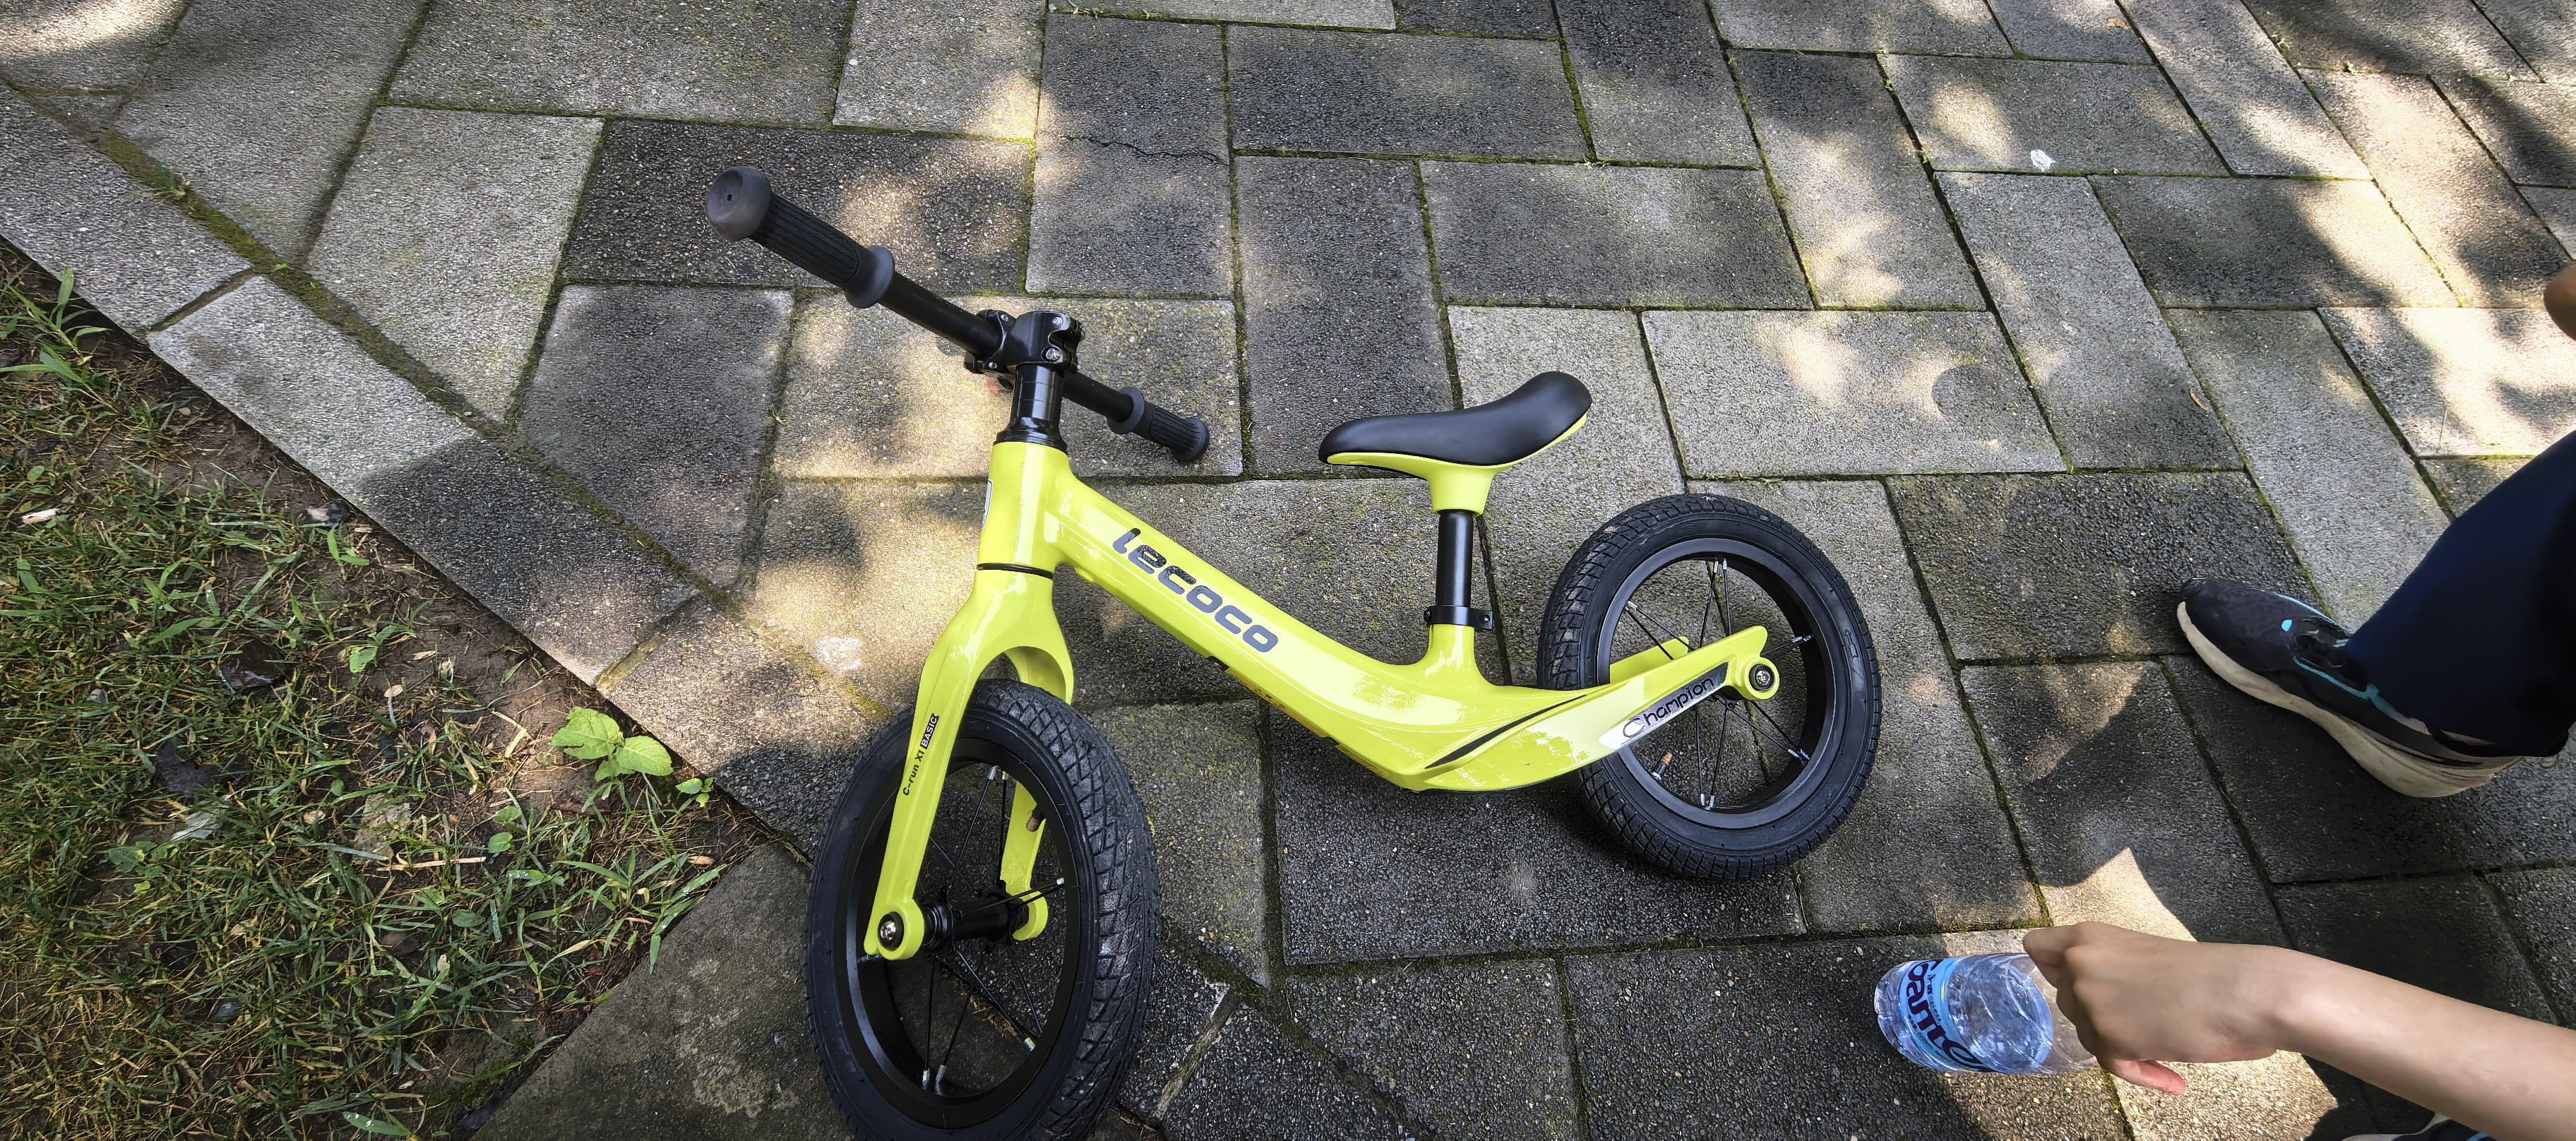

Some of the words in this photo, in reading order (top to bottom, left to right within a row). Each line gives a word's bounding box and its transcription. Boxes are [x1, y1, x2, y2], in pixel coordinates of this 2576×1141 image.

[1112, 527, 1279, 653] lecoco
[902, 764, 919, 796] C-run
[915, 749, 925, 763] X1
[921, 715, 938, 748] BASIC
[1622, 676, 1715, 739] Champion
[1907, 959, 1999, 1073] Gante
